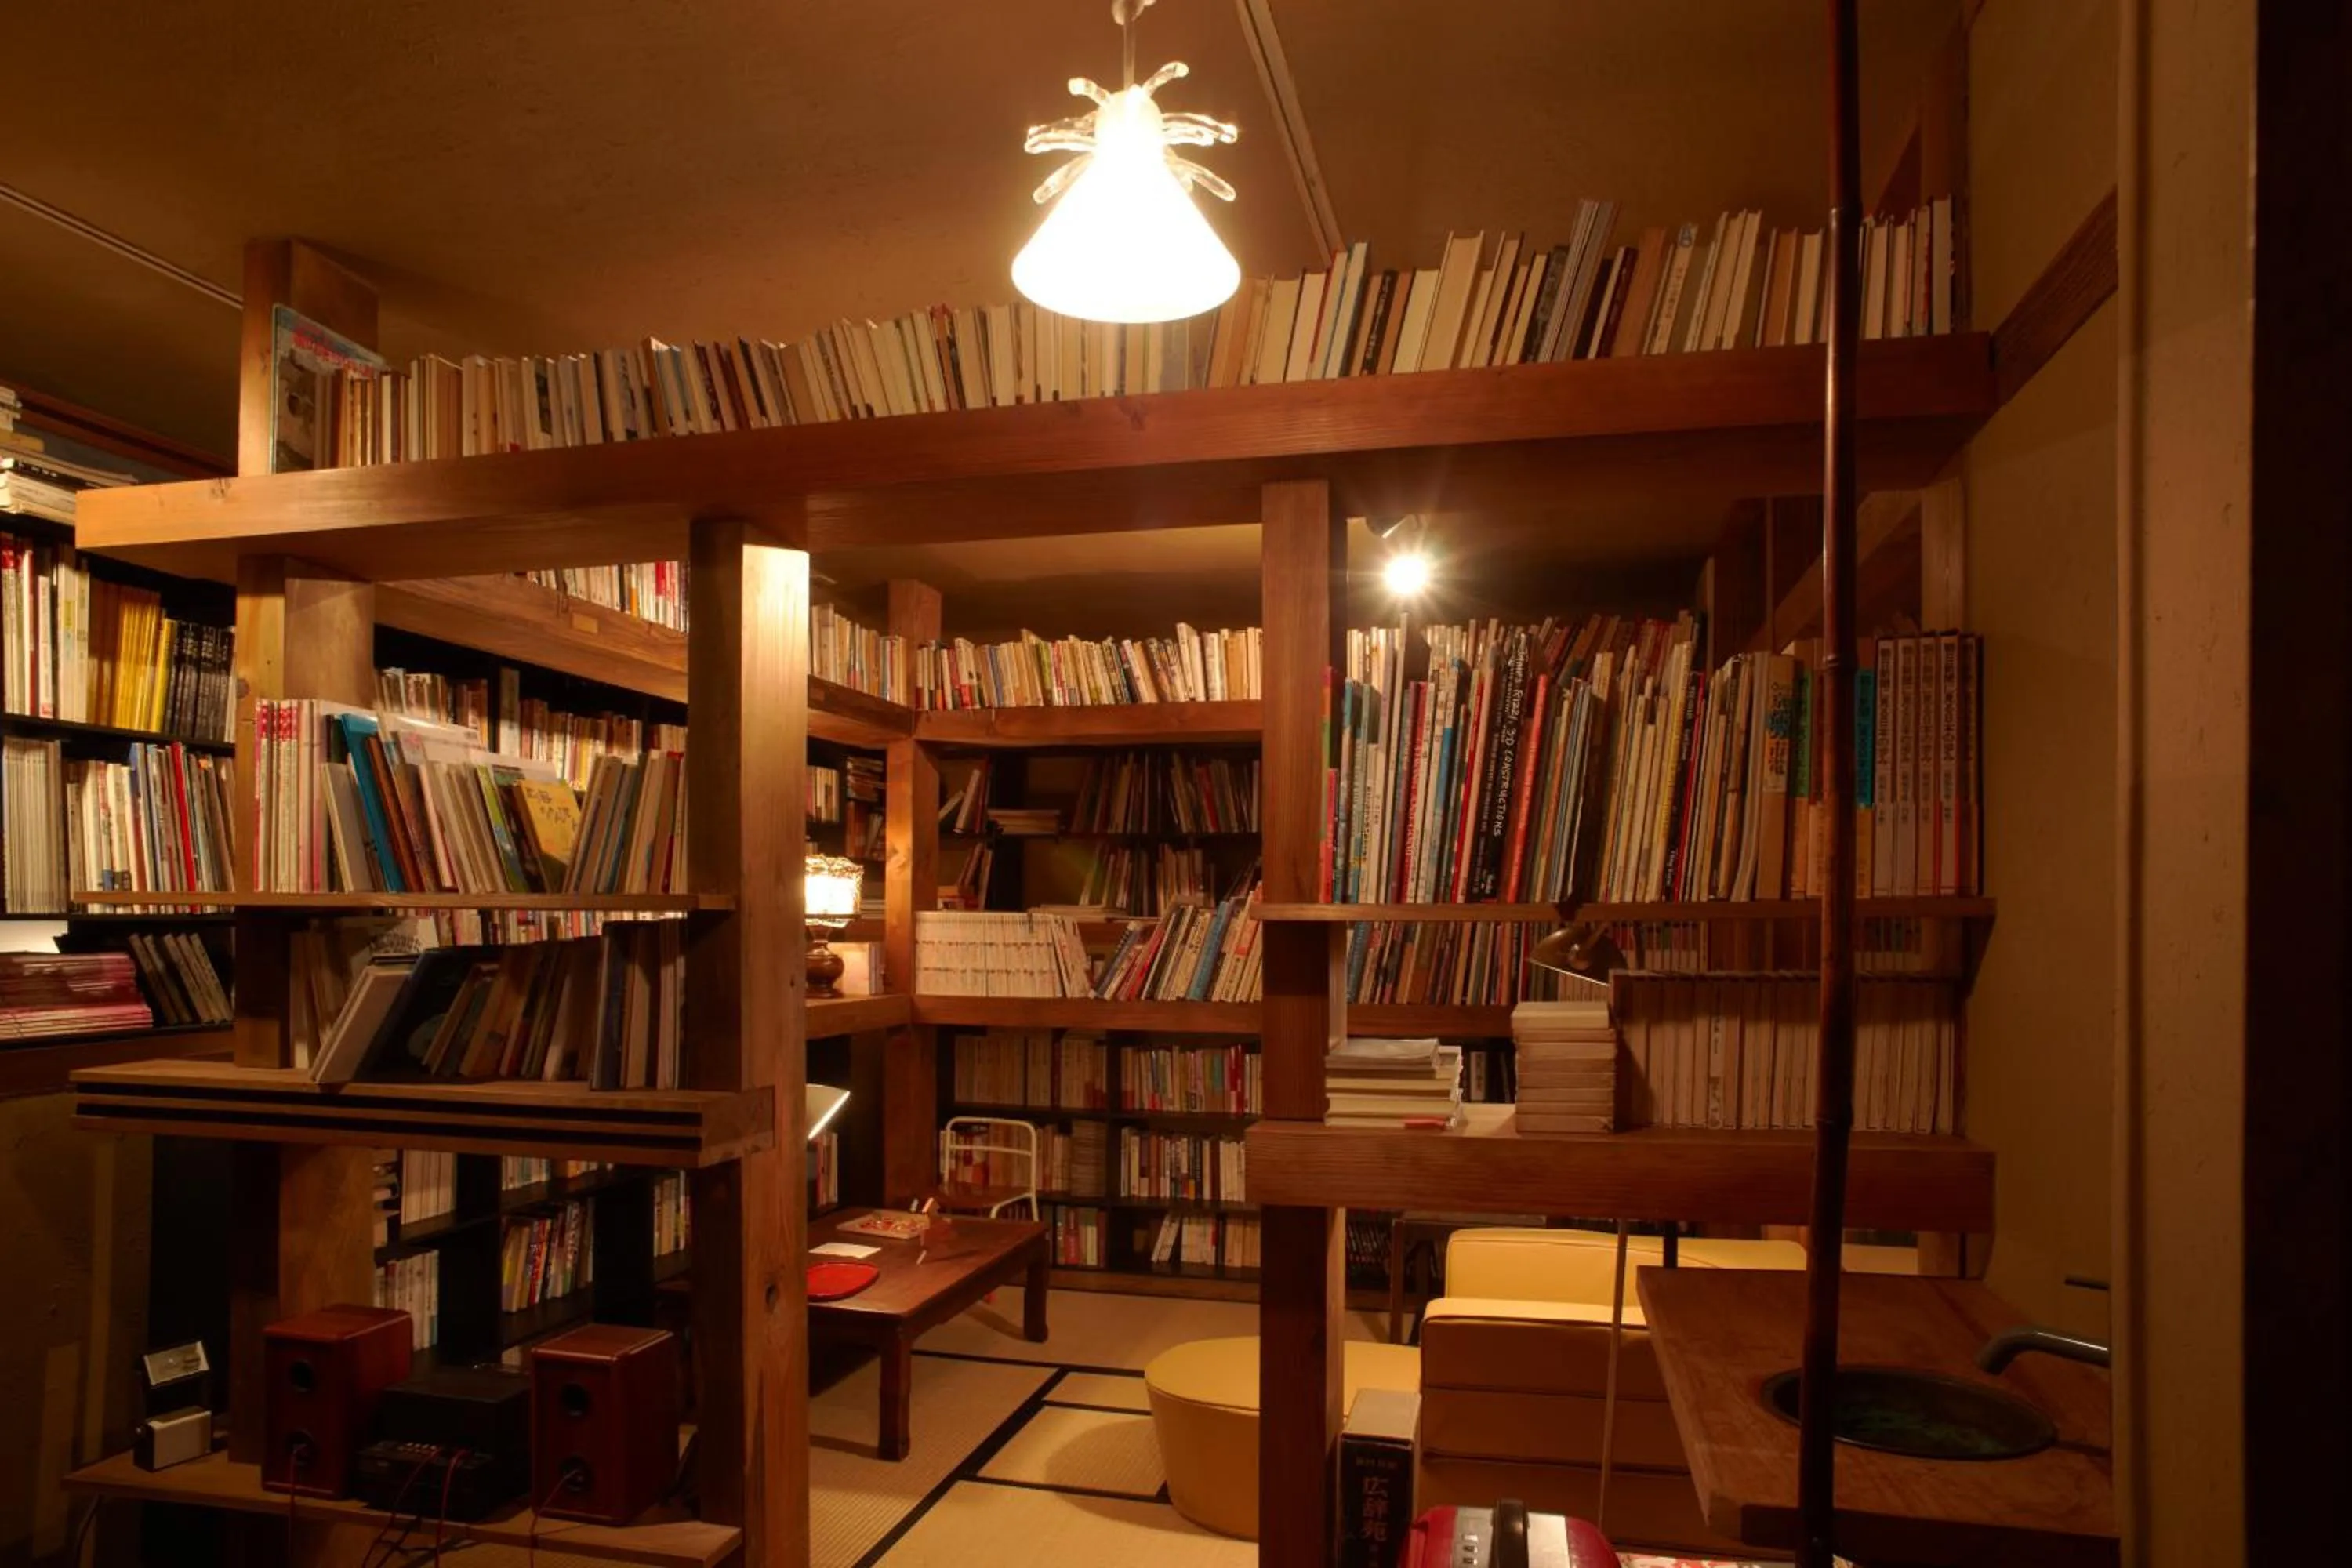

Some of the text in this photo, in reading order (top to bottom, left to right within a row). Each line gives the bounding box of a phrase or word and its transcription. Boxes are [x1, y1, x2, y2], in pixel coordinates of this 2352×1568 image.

[1494, 749, 1514, 836] CONSTRUCTIONS
[1361, 1477, 1389, 1542] 広辞苑
